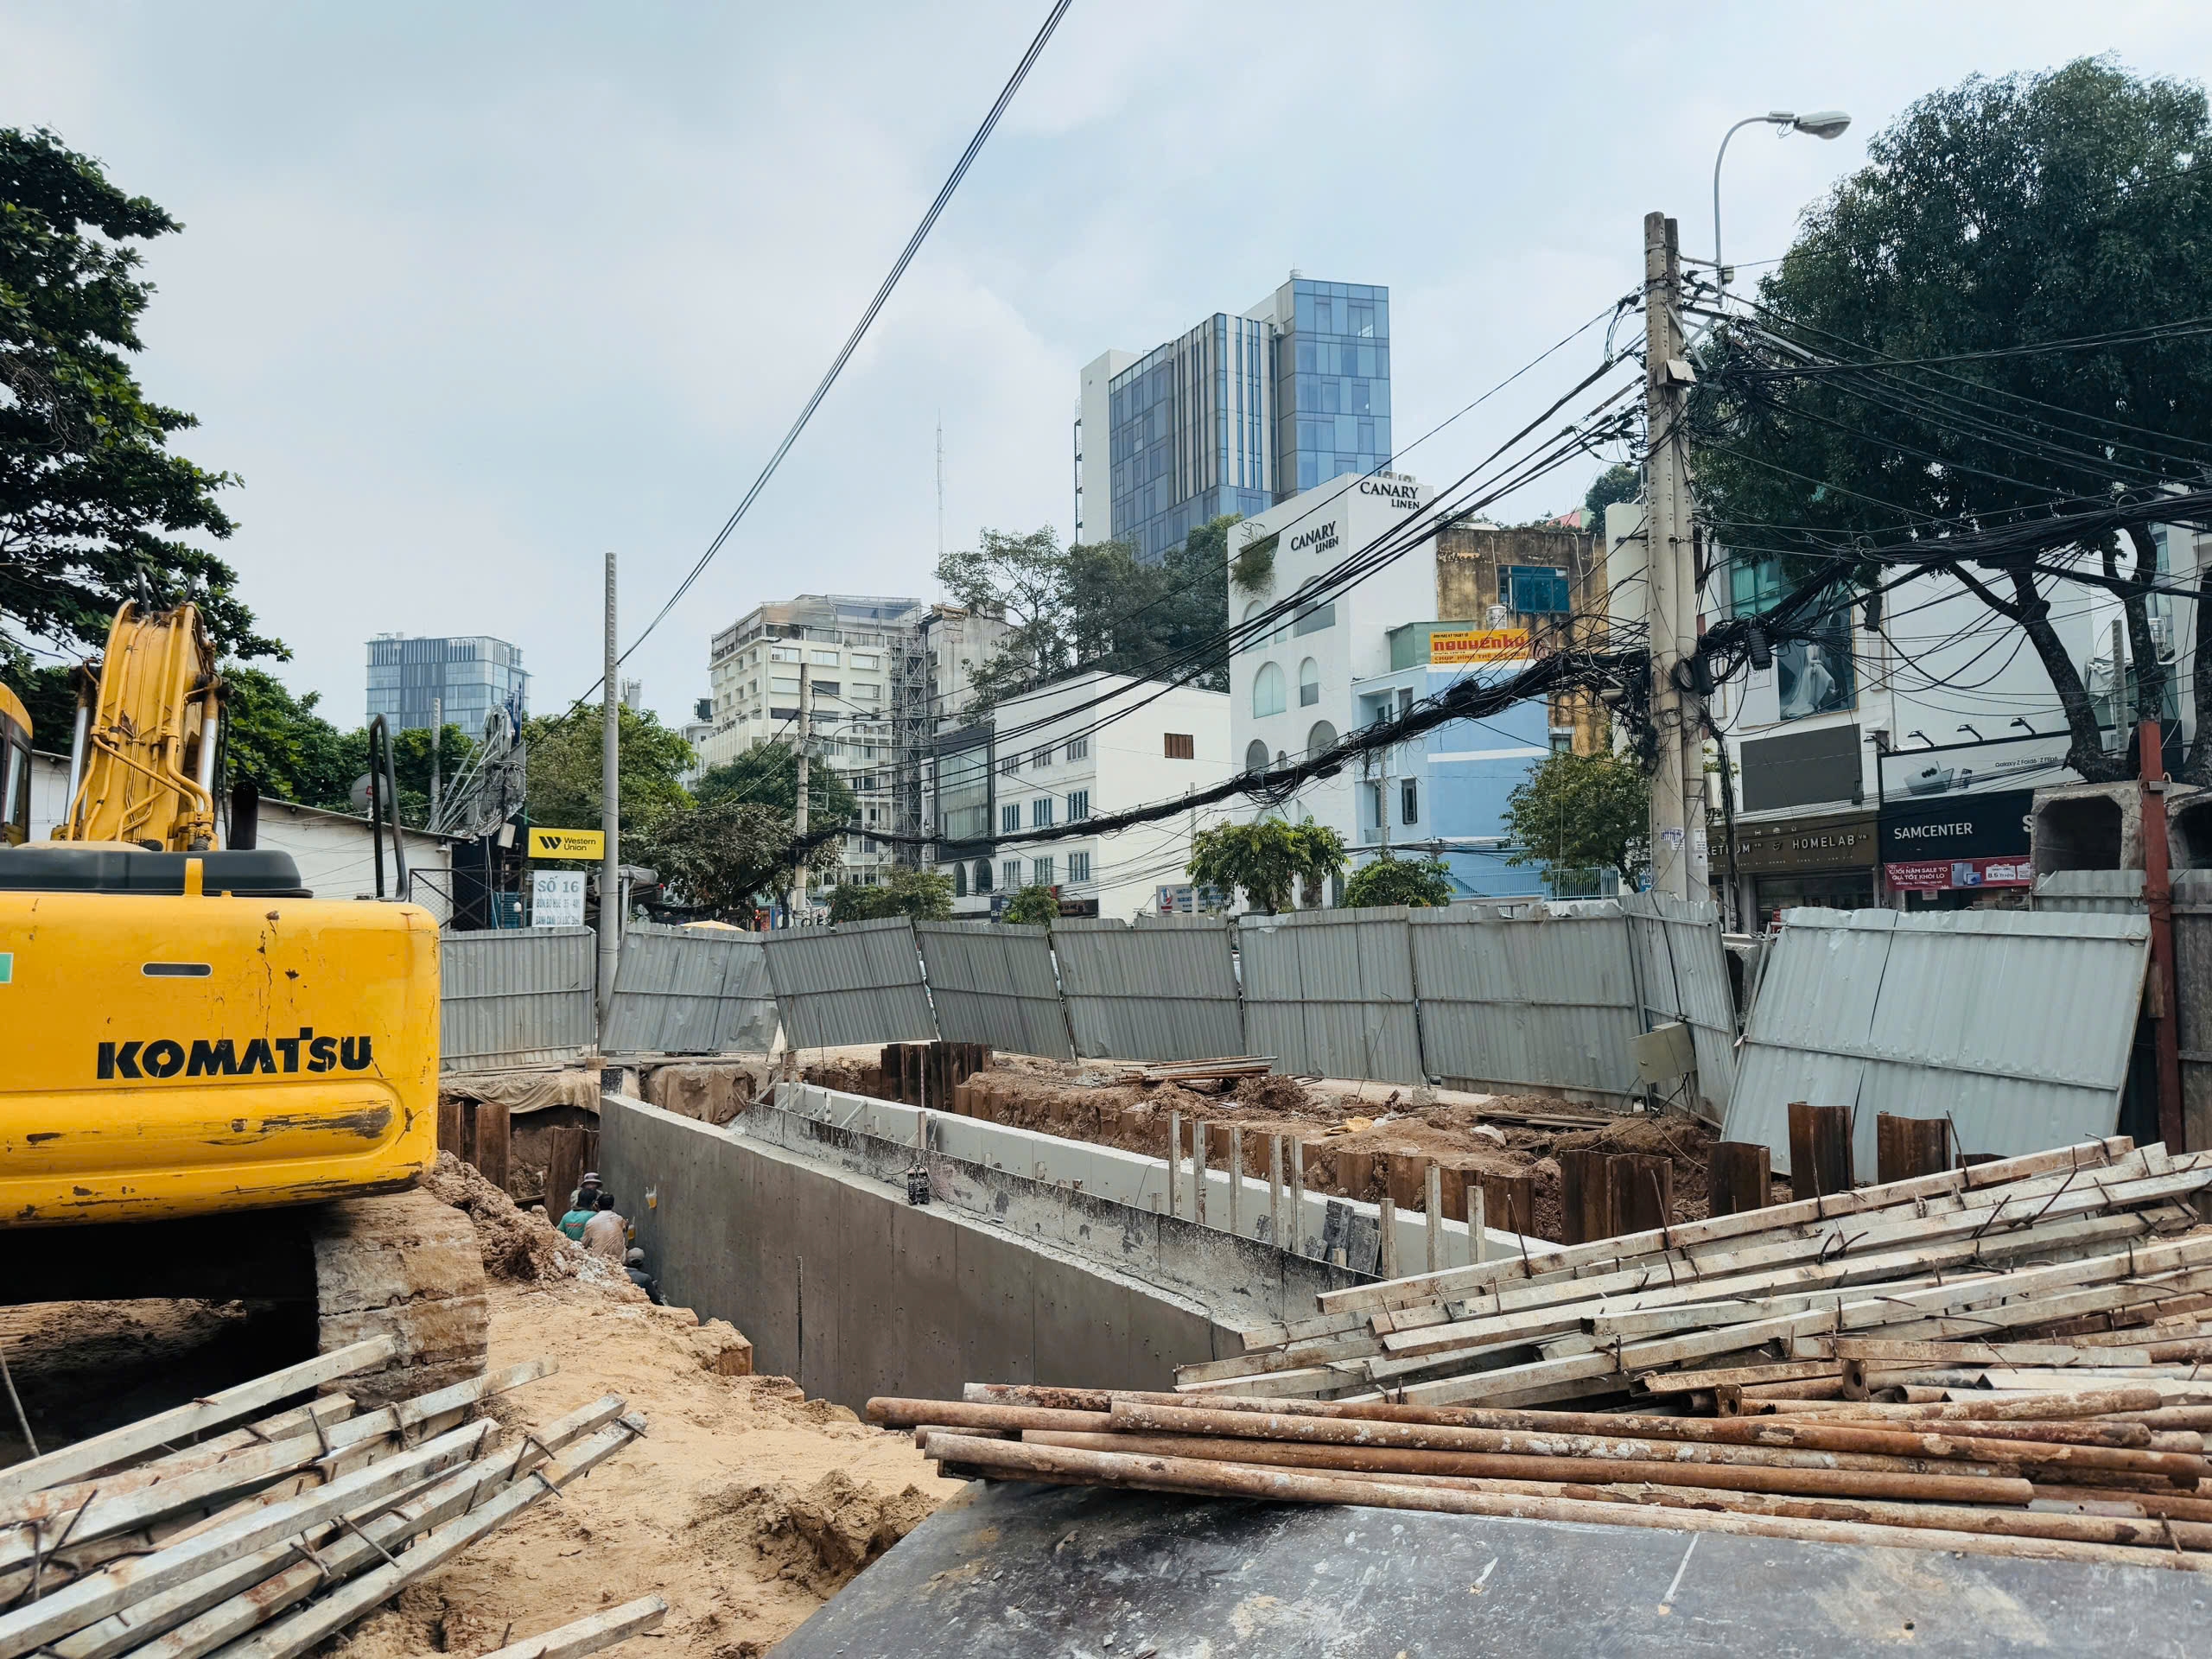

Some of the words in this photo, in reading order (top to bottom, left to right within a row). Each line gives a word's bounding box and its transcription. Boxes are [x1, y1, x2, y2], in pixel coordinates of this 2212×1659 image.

[1360, 482, 1419, 499] CANARY
[1391, 499, 1420, 509] LINEN
[1291, 521, 1336, 550] CANARY
[1315, 536, 1338, 554] LINEN
[1894, 823, 1973, 840] SAMCENTER
[1792, 835, 1855, 849] HOMELAB
[537, 875, 558, 893] SỐ
[563, 880, 580, 893] 16
[97, 1027, 372, 1079] KOMATSU
